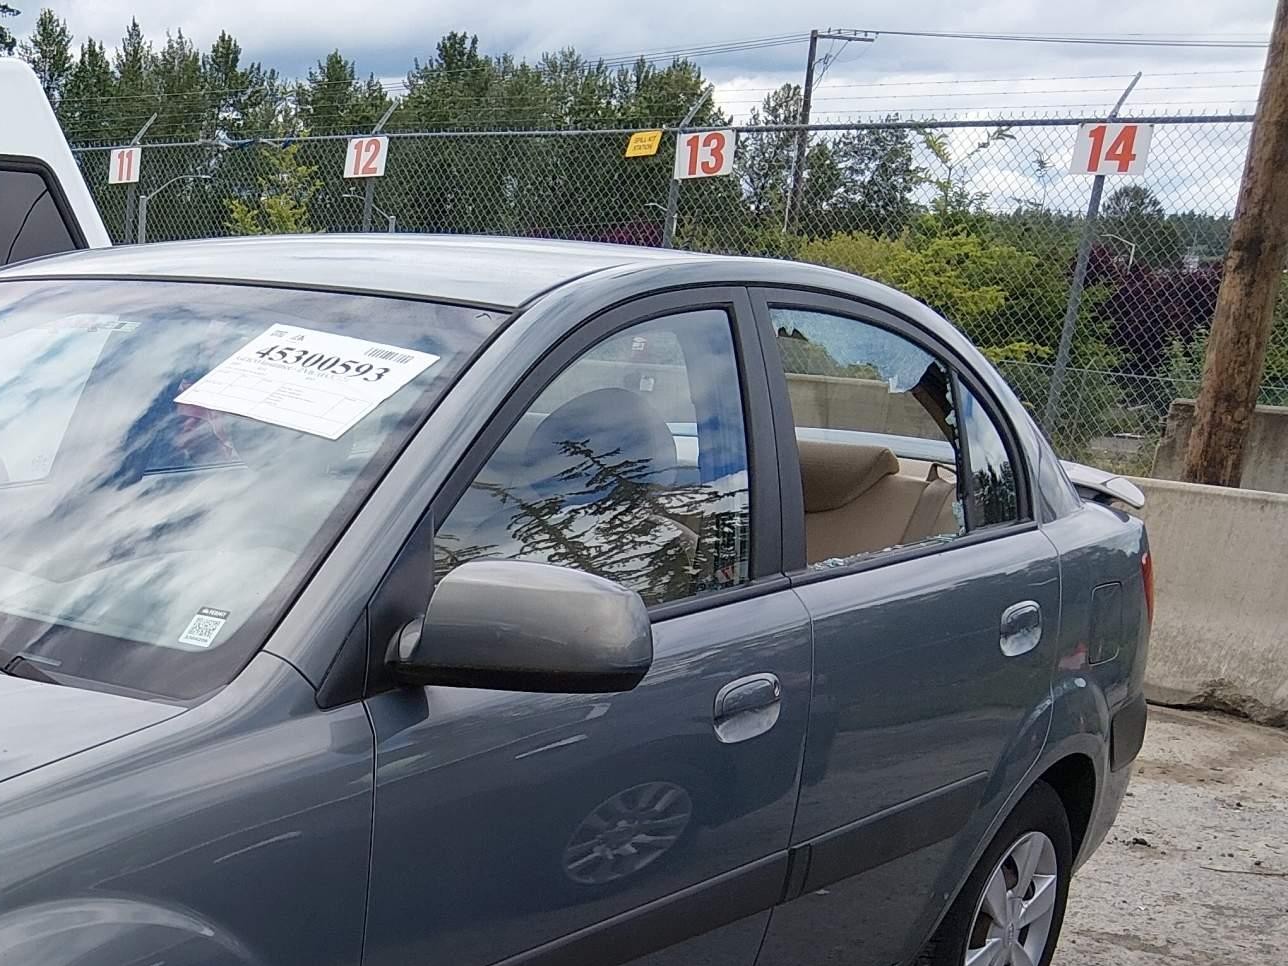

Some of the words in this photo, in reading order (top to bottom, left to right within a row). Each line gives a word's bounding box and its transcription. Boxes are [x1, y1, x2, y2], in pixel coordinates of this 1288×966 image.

[118, 150, 133, 181] 11
[353, 138, 381, 175] 12
[686, 132, 726, 176] 13
[1087, 125, 1138, 172] 14
[255, 345, 390, 382] 45300593
